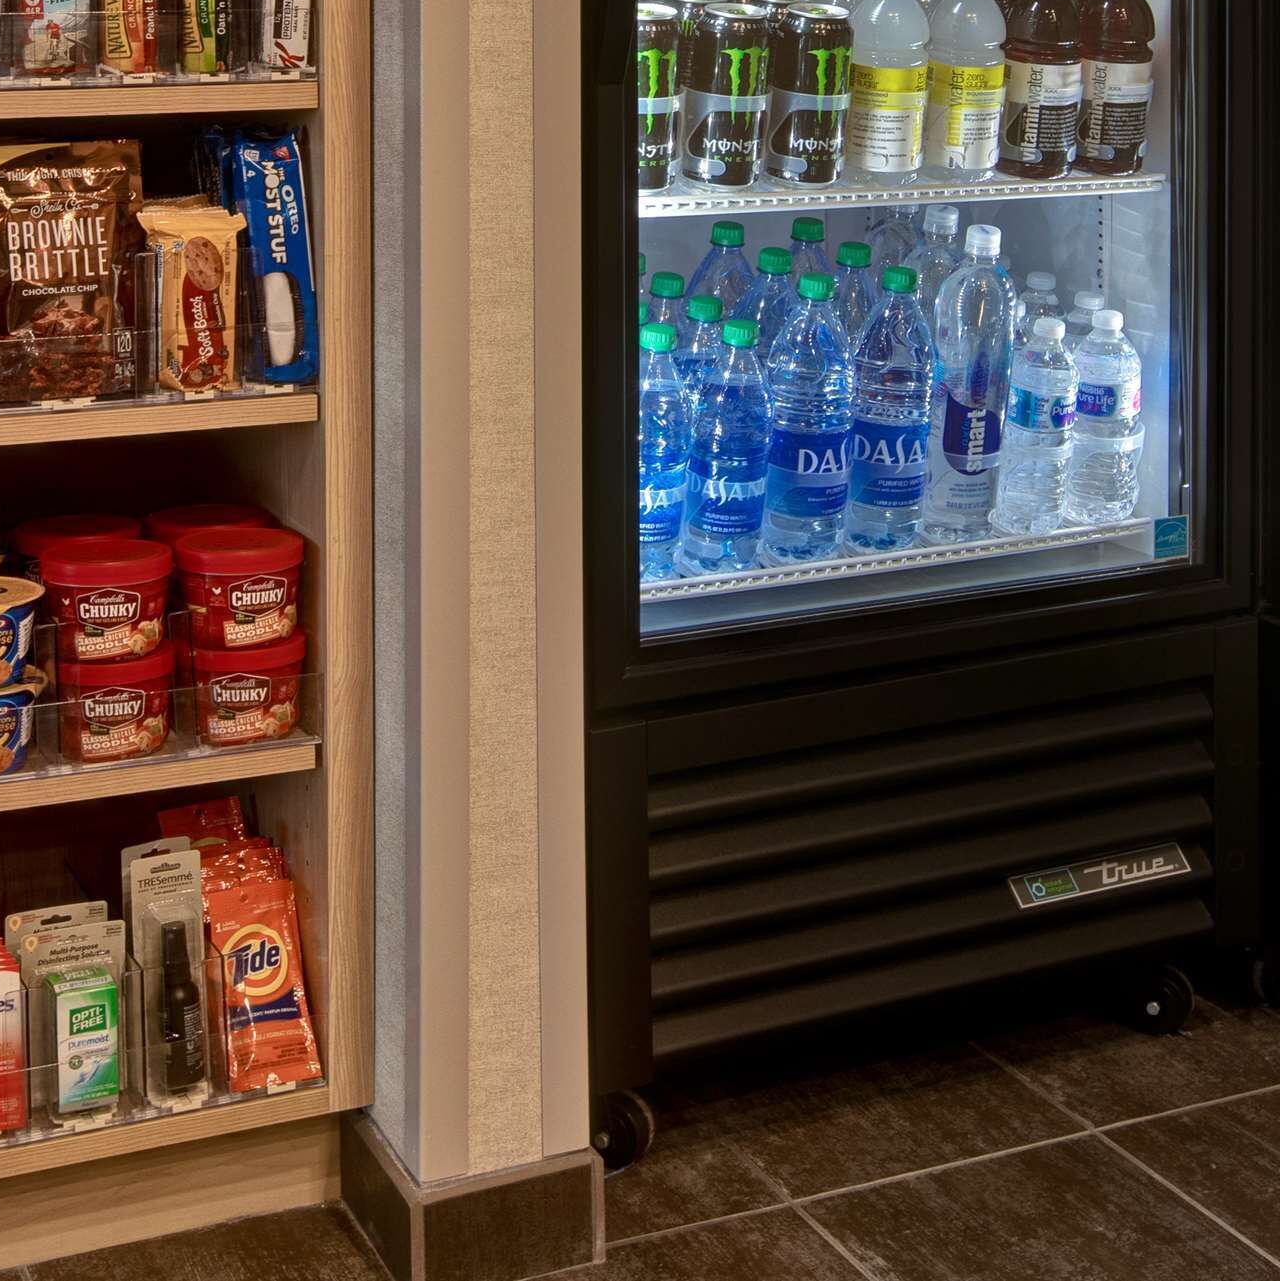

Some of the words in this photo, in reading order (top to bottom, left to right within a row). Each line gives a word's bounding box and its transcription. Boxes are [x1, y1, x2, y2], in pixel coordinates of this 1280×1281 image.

[145, 6, 155, 40] Peanut
[217, 13, 227, 35] Oats
[283, 0, 293, 38] PROTEIN
[108, 10, 128, 55] NATURE
[277, 167, 286, 181] THE
[261, 160, 282, 210] MOST
[281, 184, 299, 235] OREO
[7, 216, 108, 251] BROWNIE
[267, 214, 288, 264] STUF
[8, 246, 110, 282] BRITTLE
[22, 286, 76, 297] CHOCOLATE
[77, 284, 99, 294] CHIP
[192, 295, 207, 329] Batch
[116, 334, 132, 353] 120
[198, 330, 214, 357] Soft
[231, 588, 284, 606] CHUNKY
[79, 601, 137, 620] CHUNKY
[225, 623, 255, 635] CLASSIC
[227, 624, 281, 640] NOODLE
[77, 635, 105, 646] CLASSIC
[78, 638, 131, 653] NOODLE
[213, 685, 268, 702] CHUNKY
[84, 699, 141, 718] CHUNKY
[209, 720, 264, 736] NOODLE
[81, 733, 110, 745] CLASSIC
[83, 735, 136, 751] NOODLE
[1083, 857, 1176, 884] true
[136, 871, 193, 890] TRESemmé
[37, 954, 81, 967] Disinfecting
[81, 949, 111, 961] Solution
[49, 942, 99, 957] Multi-Purpose
[227, 938, 281, 987] Tide
[71, 1006, 104, 1024] OPTI-
[72, 1016, 105, 1033] FREE
[68, 1034, 111, 1051] puremoist
